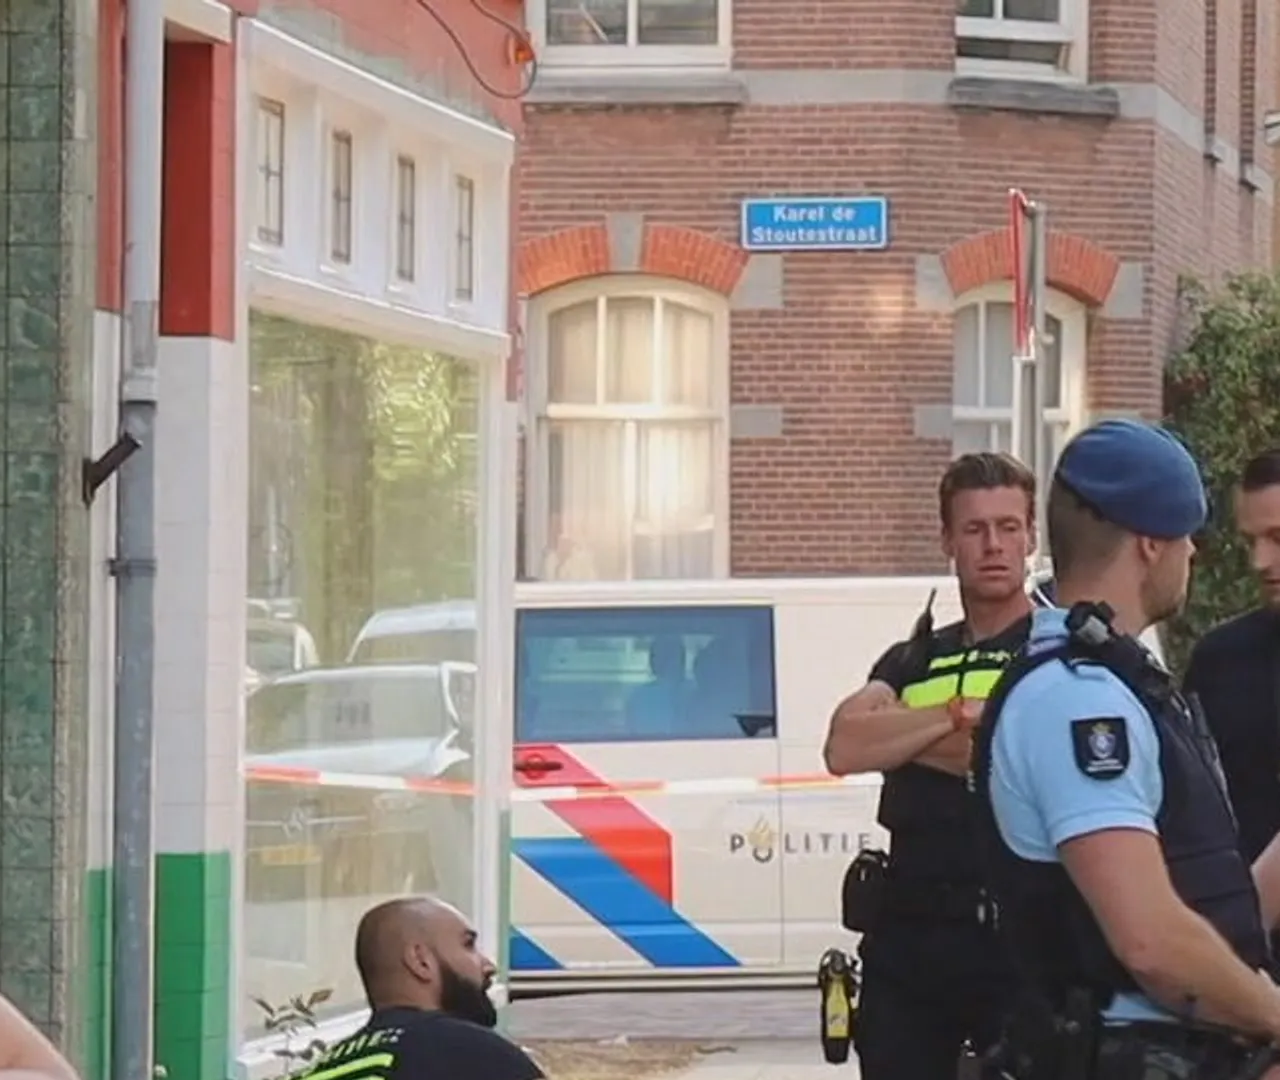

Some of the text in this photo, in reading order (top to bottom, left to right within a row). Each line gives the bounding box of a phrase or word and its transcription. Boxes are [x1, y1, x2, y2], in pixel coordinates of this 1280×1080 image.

[773, 205, 857, 222] Karel de
[752, 226, 878, 243] Stoutestraat
